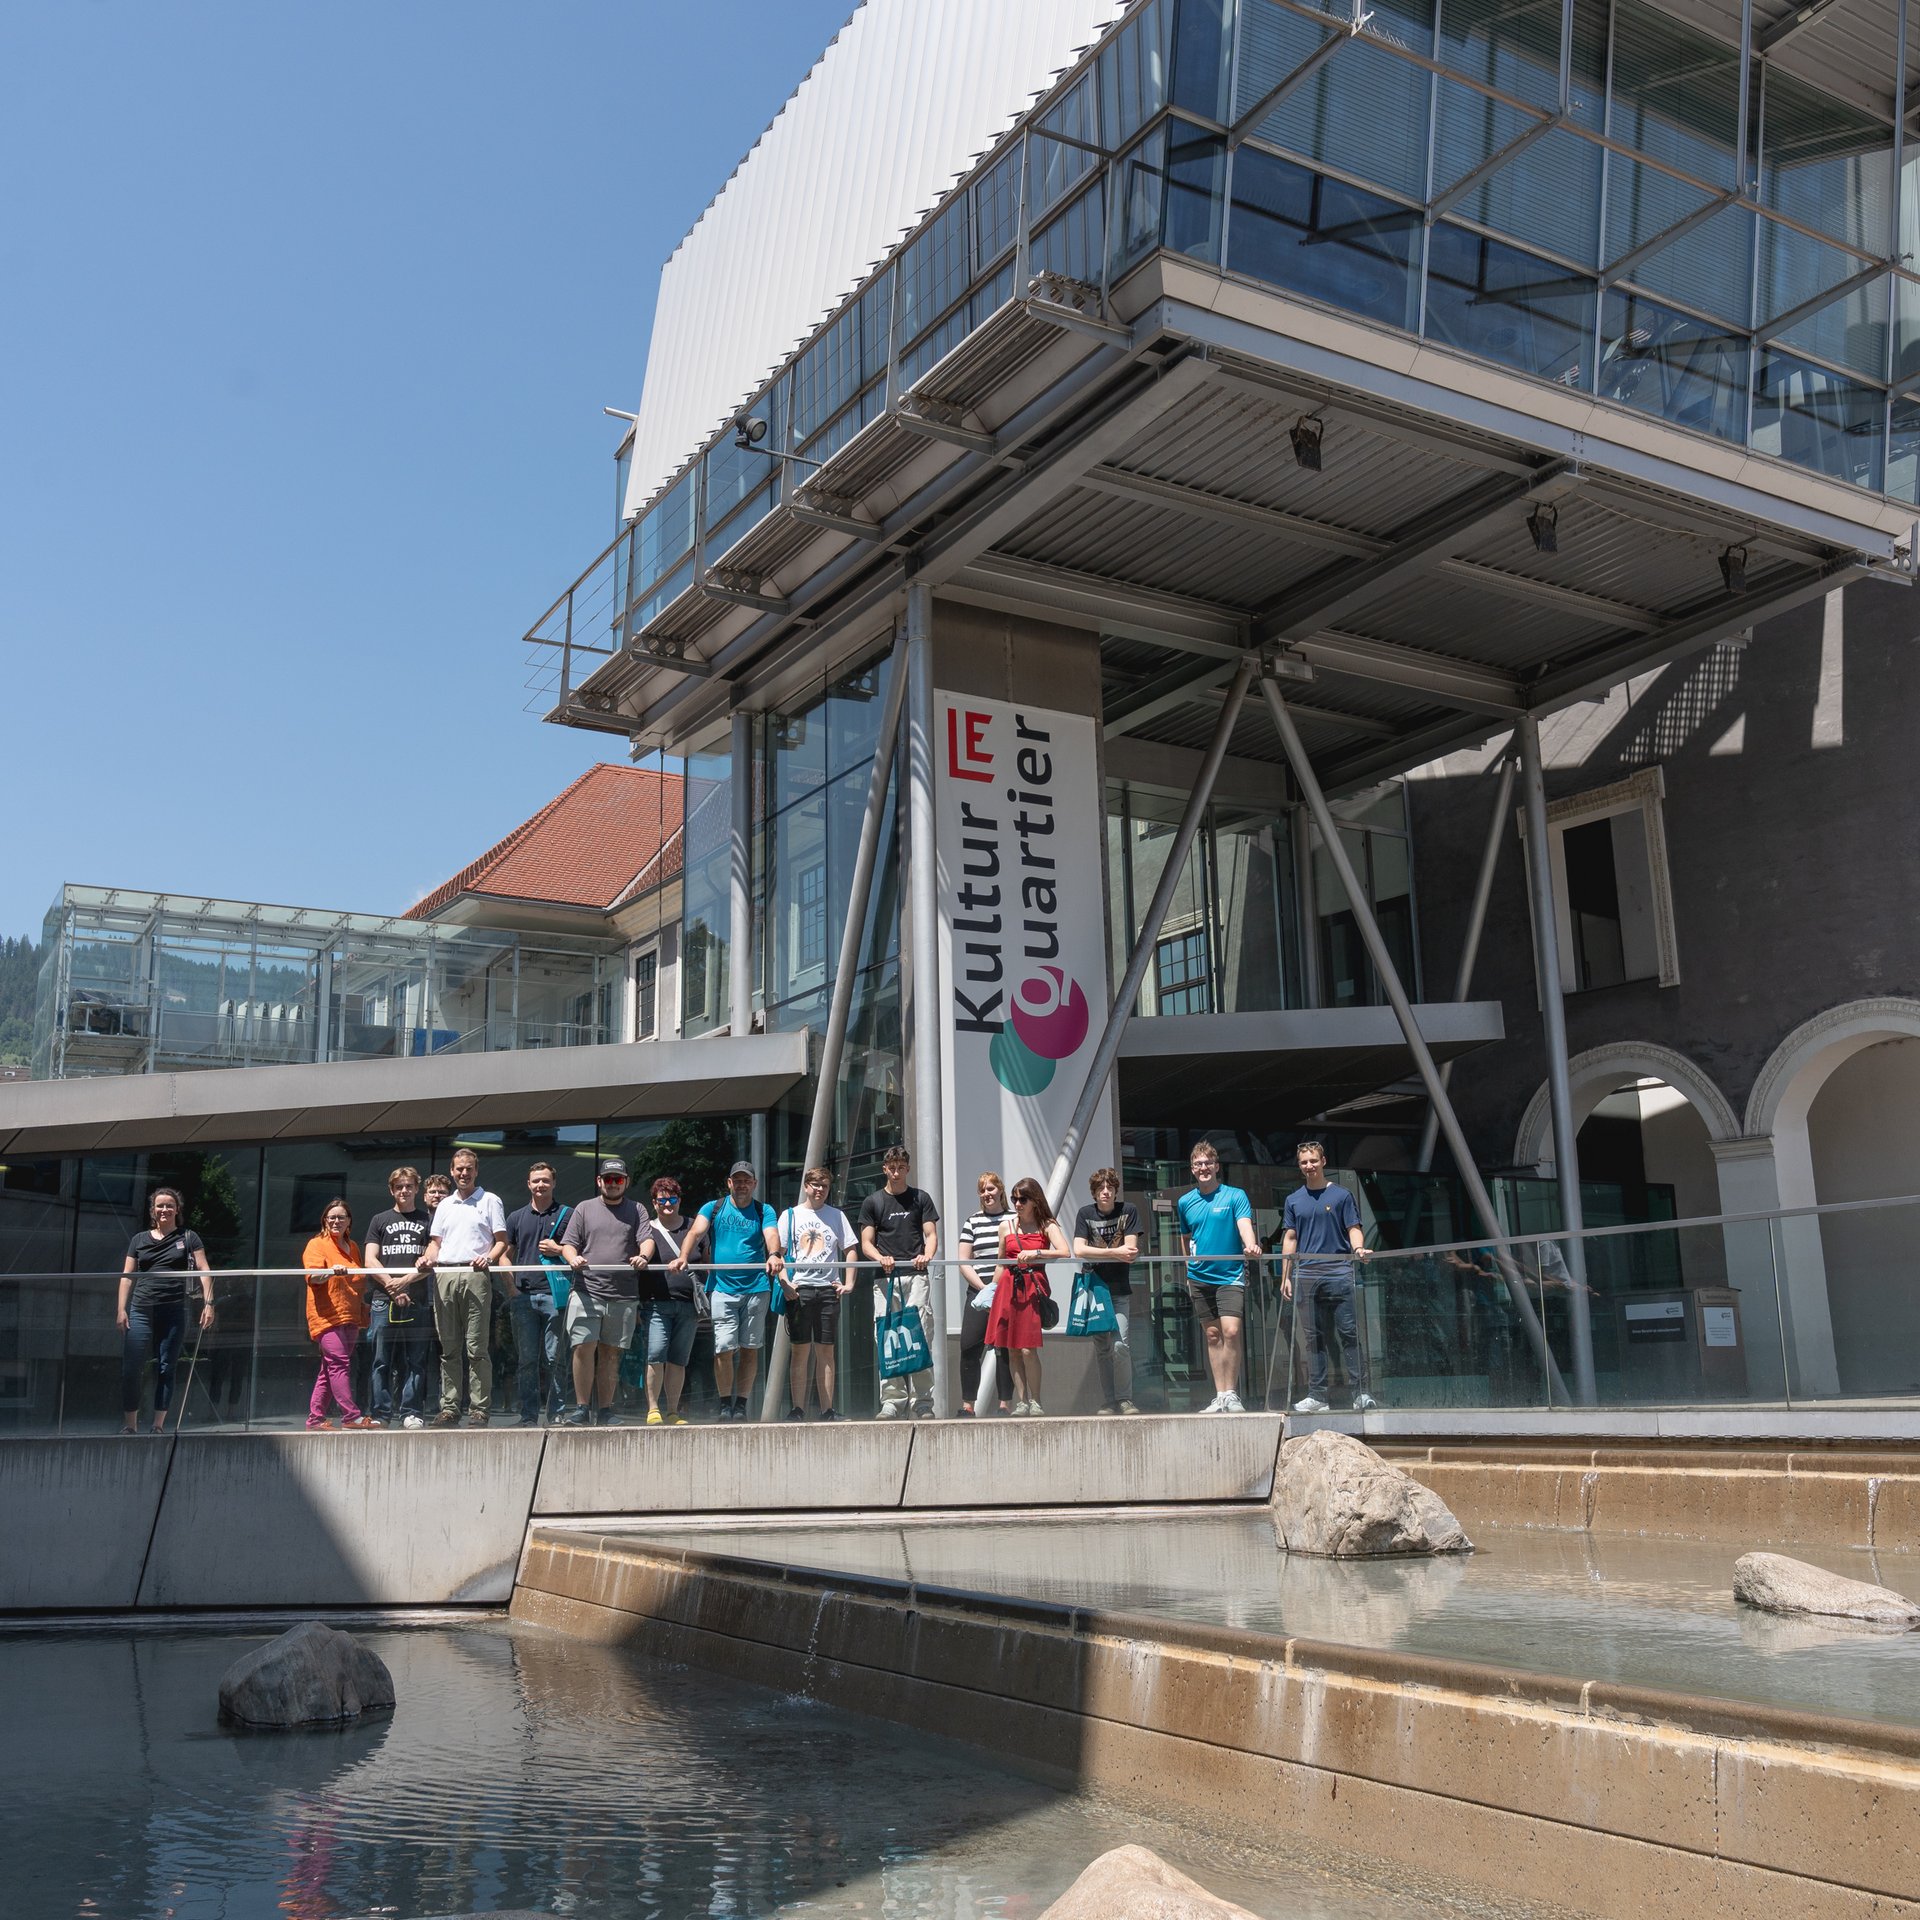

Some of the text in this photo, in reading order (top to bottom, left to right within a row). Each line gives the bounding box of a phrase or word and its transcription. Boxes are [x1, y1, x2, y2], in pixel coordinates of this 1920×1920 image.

[953, 800, 1004, 1034] Kultur
[1006, 713, 1073, 1017] Quartier
[385, 1220, 425, 1234] CORTEIZ
